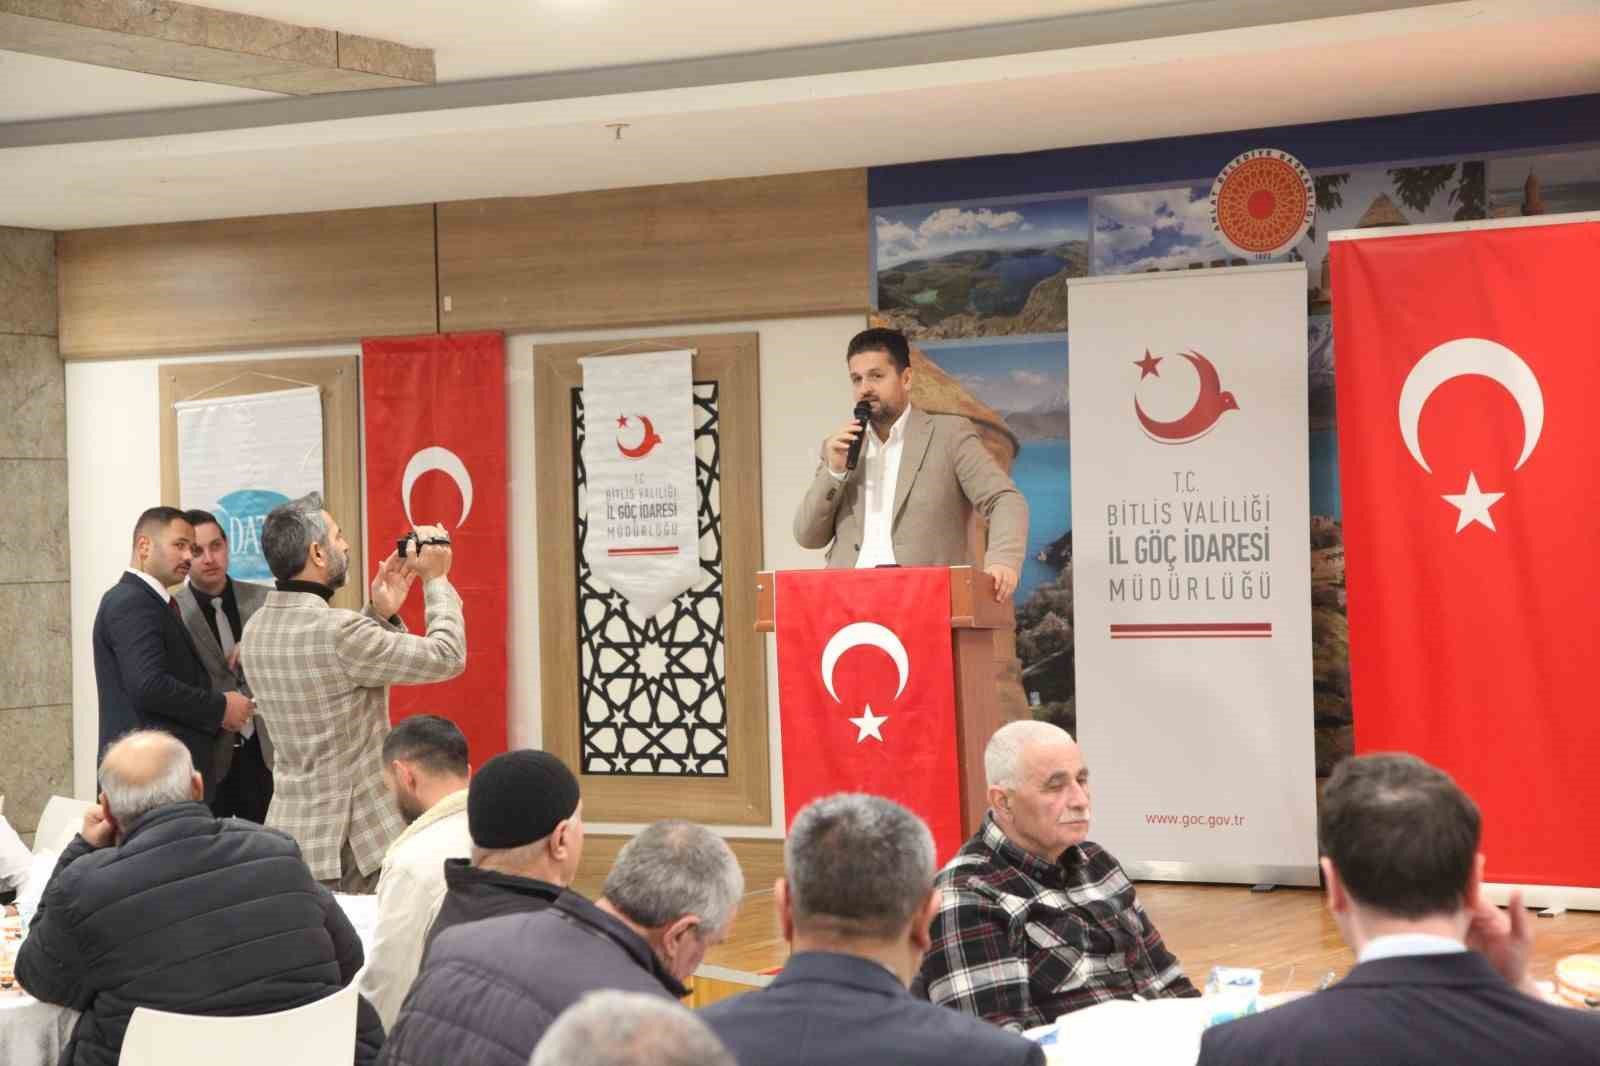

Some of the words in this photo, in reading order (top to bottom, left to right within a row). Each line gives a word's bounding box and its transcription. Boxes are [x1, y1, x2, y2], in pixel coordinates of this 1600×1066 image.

[1173, 471, 1199, 493] T.C.
[617, 501, 637, 524] GÖÇ
[640, 499, 677, 520] İDARESİ
[1107, 499, 1172, 526] BİTLİS
[1183, 494, 1271, 524] VALİLİĞİ
[607, 520, 679, 538] MÜDÜRLÜĞÜ
[1109, 530, 1128, 565] İL
[1135, 529, 1176, 572] GÖÇ
[1184, 525, 1270, 563] İDARESİ
[1109, 570, 1271, 601] MÜDÜRLÜĞÜ
[1145, 814, 1245, 828] www.goc.gov.tr
